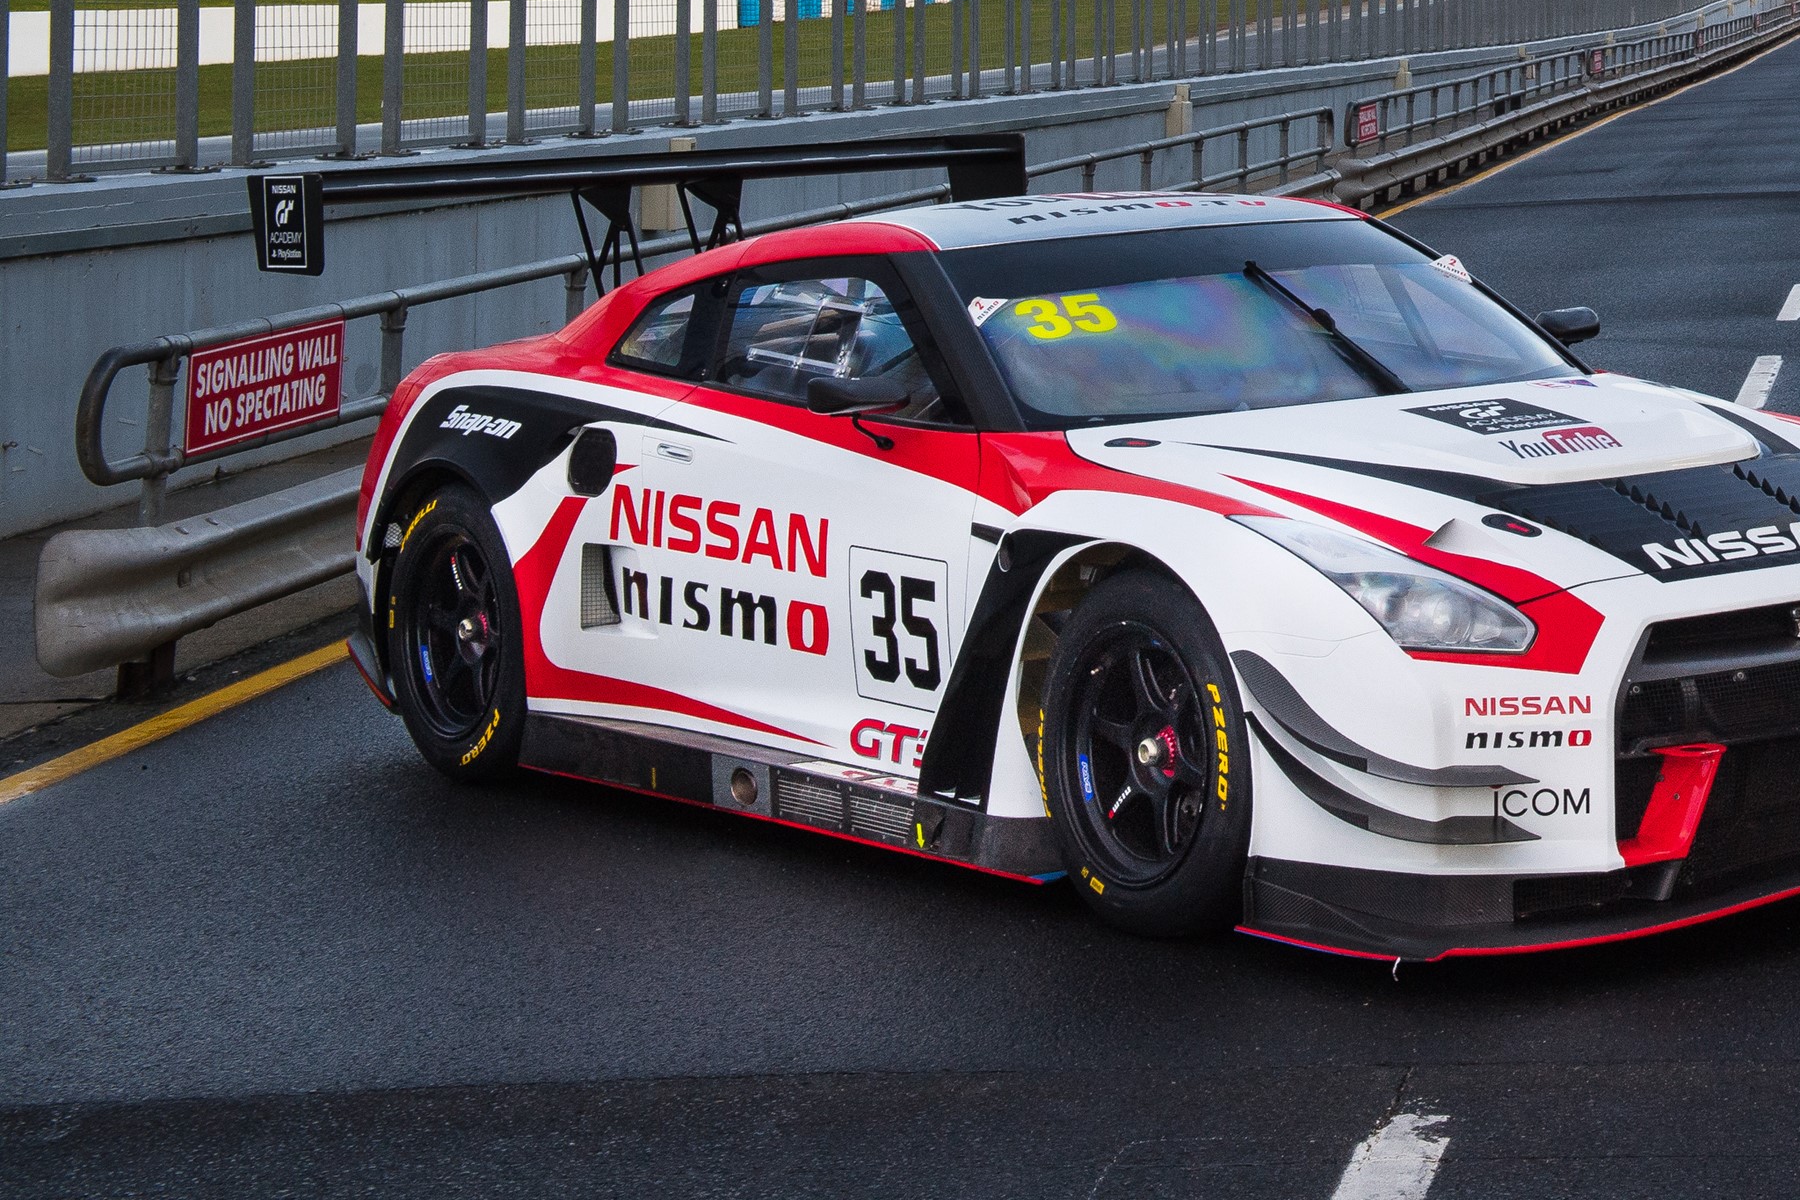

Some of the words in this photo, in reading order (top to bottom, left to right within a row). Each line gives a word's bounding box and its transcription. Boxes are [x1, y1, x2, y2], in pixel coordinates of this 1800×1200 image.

[271, 184, 297, 194] NISSAN
[269, 231, 303, 244] ACADEMY
[277, 248, 302, 261] PlayStation
[974, 301, 985, 311] 2
[976, 300, 999, 321] nismo
[1015, 293, 1117, 340] 35
[195, 342, 294, 398] SIGNALLING
[298, 333, 337, 372] WALL
[204, 397, 232, 436] NO
[235, 373, 326, 428] SPECTATING
[1427, 400, 1500, 412] NISSAN
[439, 404, 523, 440] Snap-on
[1466, 413, 1557, 428] ACADEMY
[1498, 428, 1622, 459] YouTube
[609, 483, 829, 578] NISSAN
[622, 566, 830, 656] nismo
[860, 570, 942, 692] 35
[1465, 696, 1592, 717] NISSAN
[1465, 730, 1592, 749] nismo
